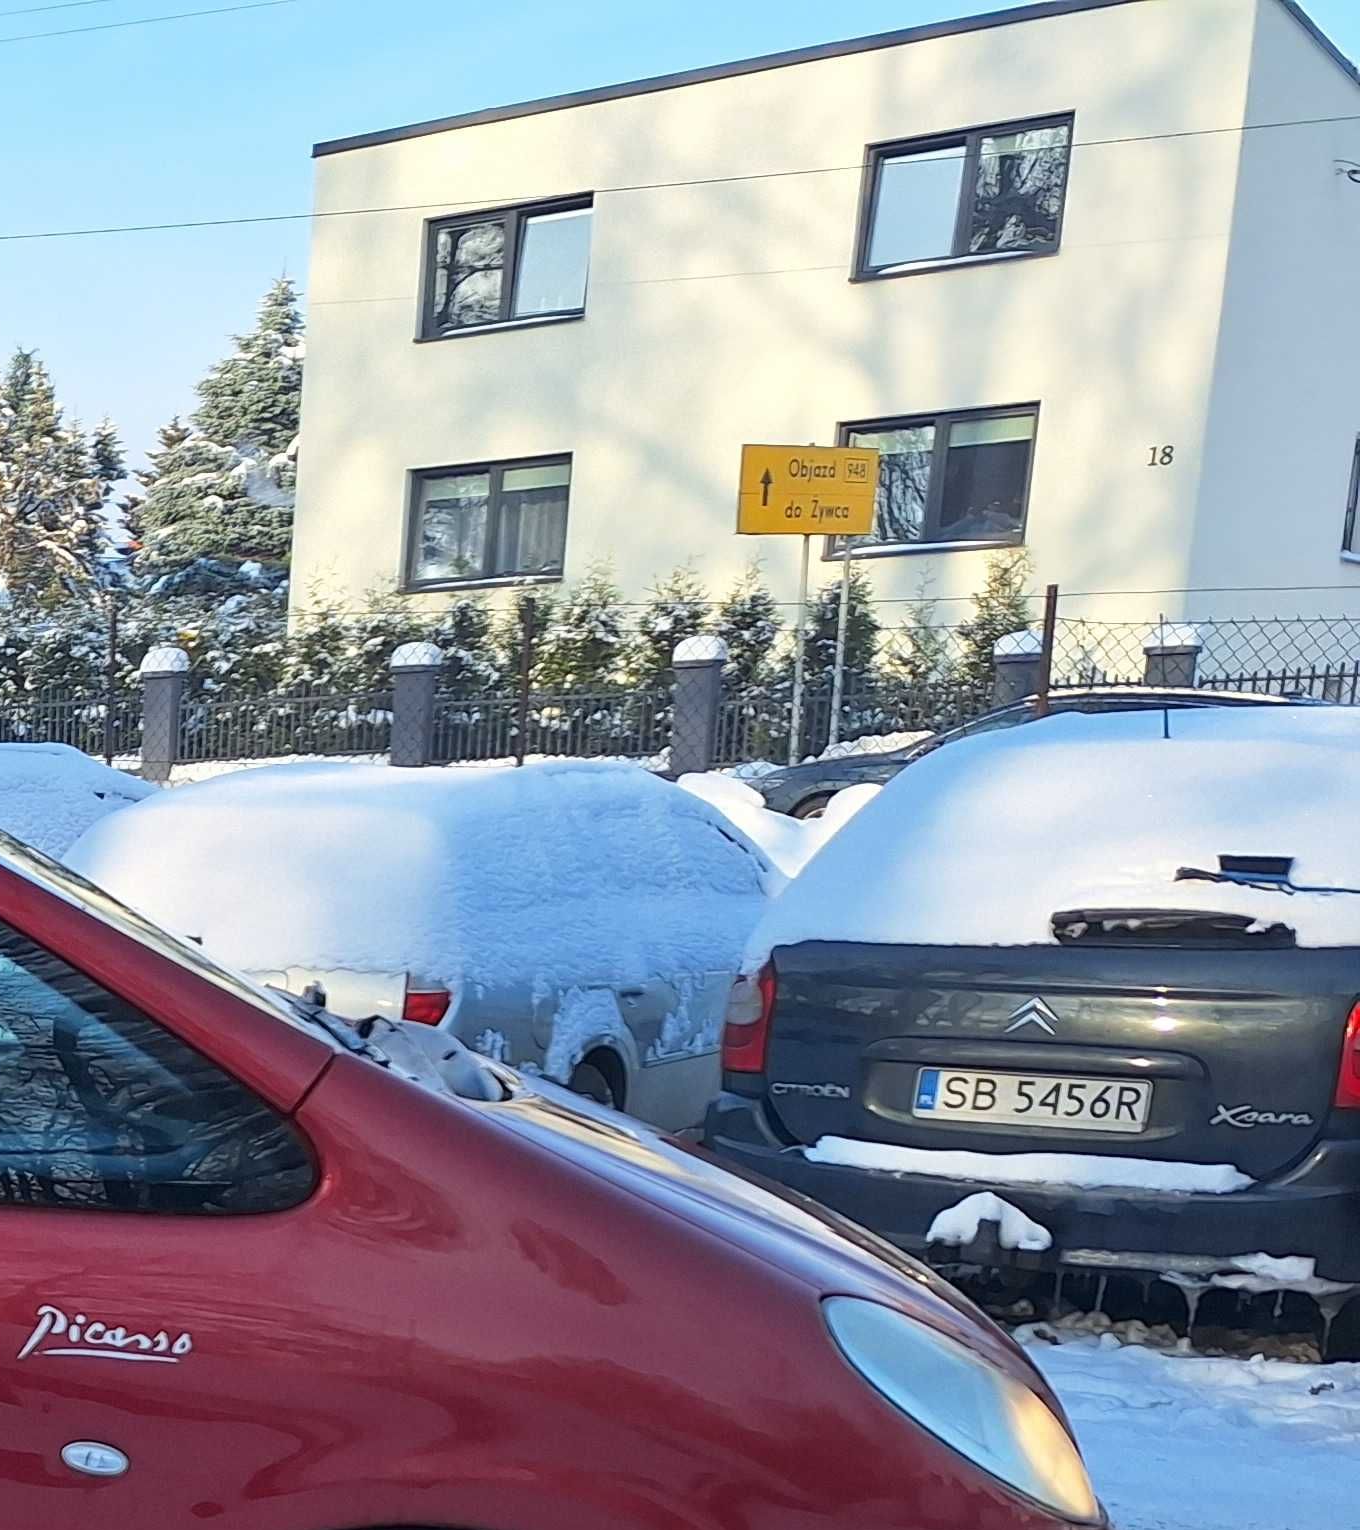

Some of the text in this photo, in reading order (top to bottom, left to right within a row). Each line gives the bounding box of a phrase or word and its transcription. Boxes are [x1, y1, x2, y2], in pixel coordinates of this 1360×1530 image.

[1147, 445, 1175, 466] 18
[788, 458, 867, 483] Objazd 948
[784, 494, 849, 523] do Żywca
[943, 1076, 998, 1111] SB
[1012, 1080, 1142, 1122] 5456R
[1209, 1104, 1314, 1128] Xsara
[17, 1305, 193, 1362] Picasso
